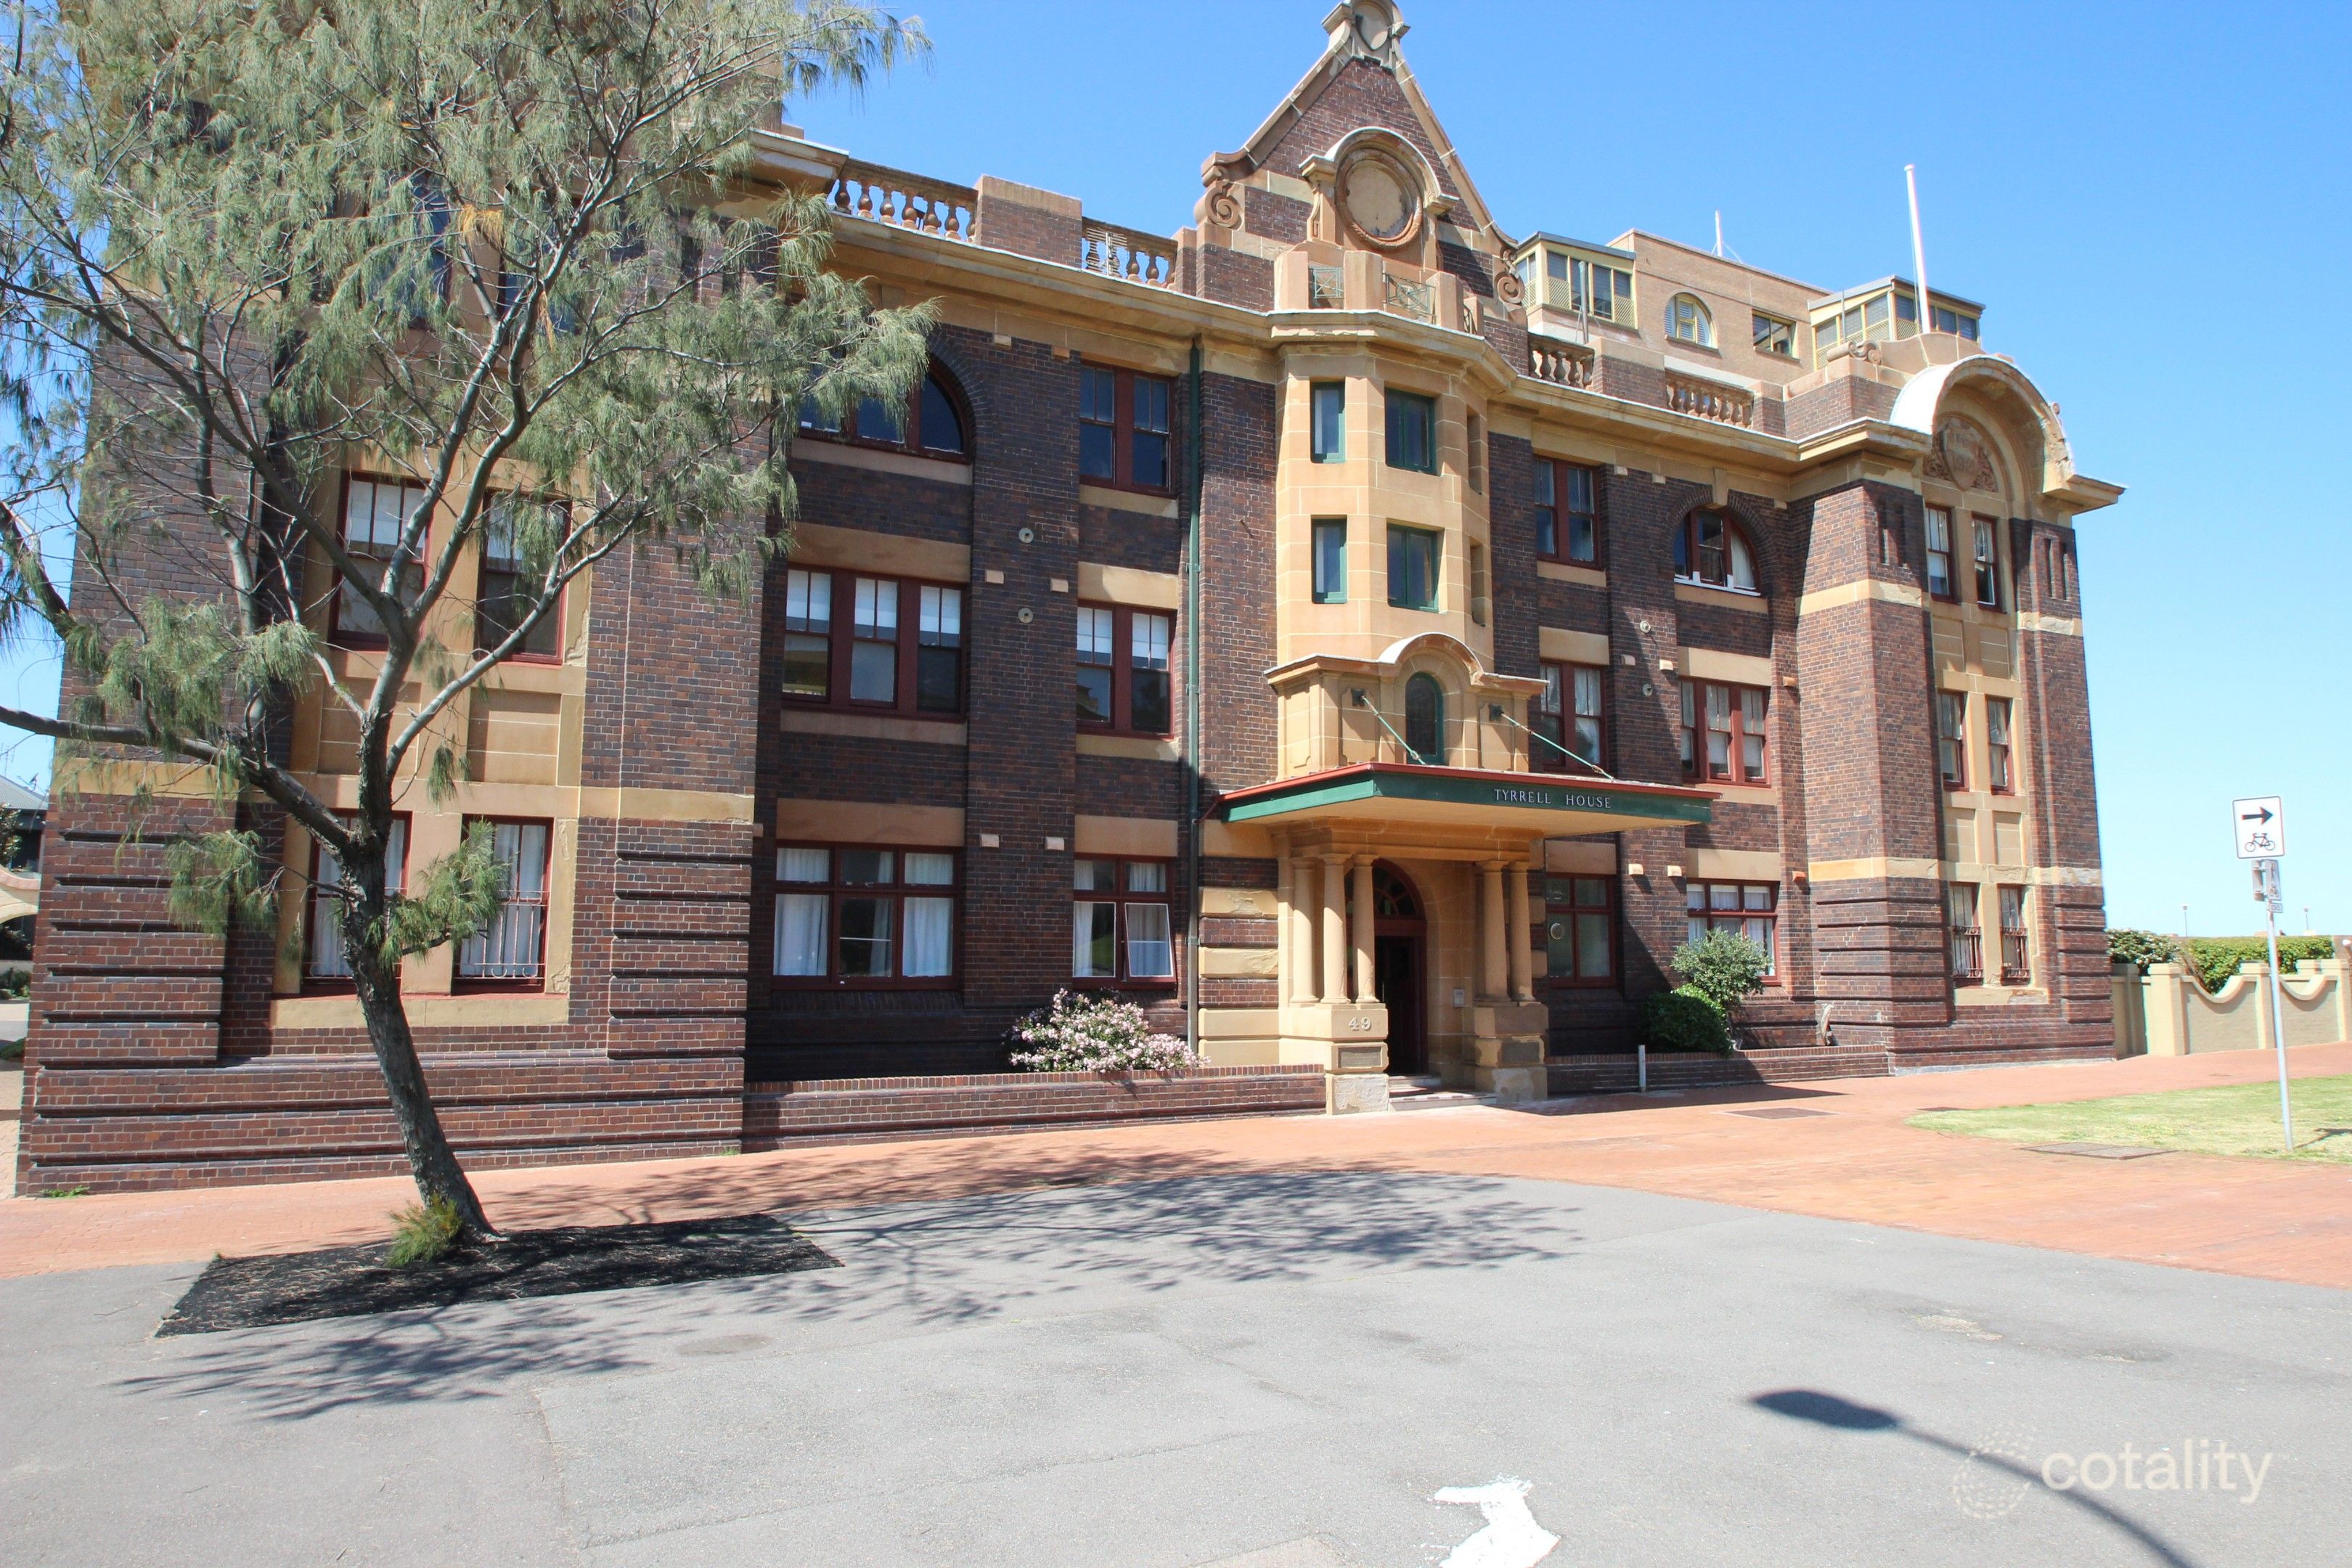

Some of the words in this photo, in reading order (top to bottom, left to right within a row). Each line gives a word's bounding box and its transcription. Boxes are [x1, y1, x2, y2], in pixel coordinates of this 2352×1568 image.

[1494, 789, 1551, 804] TYRRELL
[1566, 794, 1611, 808] HOUSE
[1348, 1016, 1371, 1031] 49
